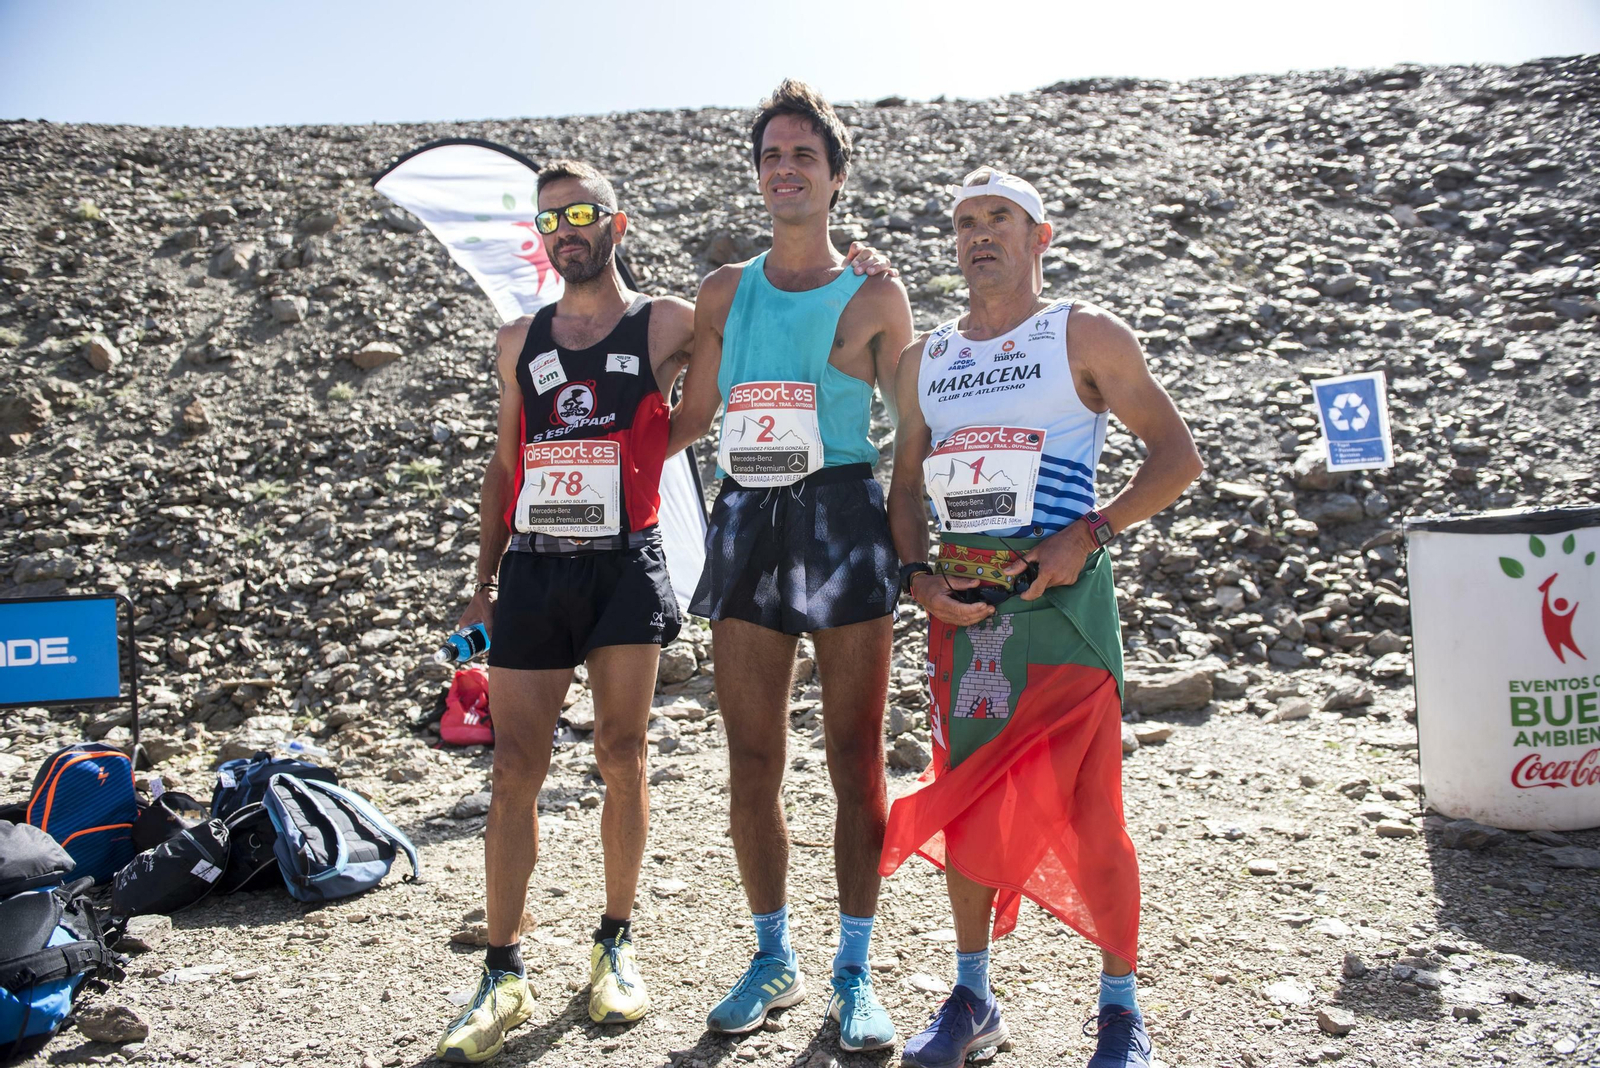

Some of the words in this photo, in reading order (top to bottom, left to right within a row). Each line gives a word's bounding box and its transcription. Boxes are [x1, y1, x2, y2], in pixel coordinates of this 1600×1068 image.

[993, 351, 1026, 363] mayfo
[927, 364, 1041, 396] MARACENA
[938, 393, 960, 403] CLUB
[975, 383, 1026, 396] ATLETISMO
[756, 415, 775, 443] 2
[755, 464, 785, 472] Premium
[970, 456, 985, 484] 1
[549, 471, 583, 496] 78
[531, 516, 555, 524] Granada
[581, 525, 598, 533] VELETA
[0, 637, 69, 667] DE
[1509, 676, 1590, 693] EVENTOS
